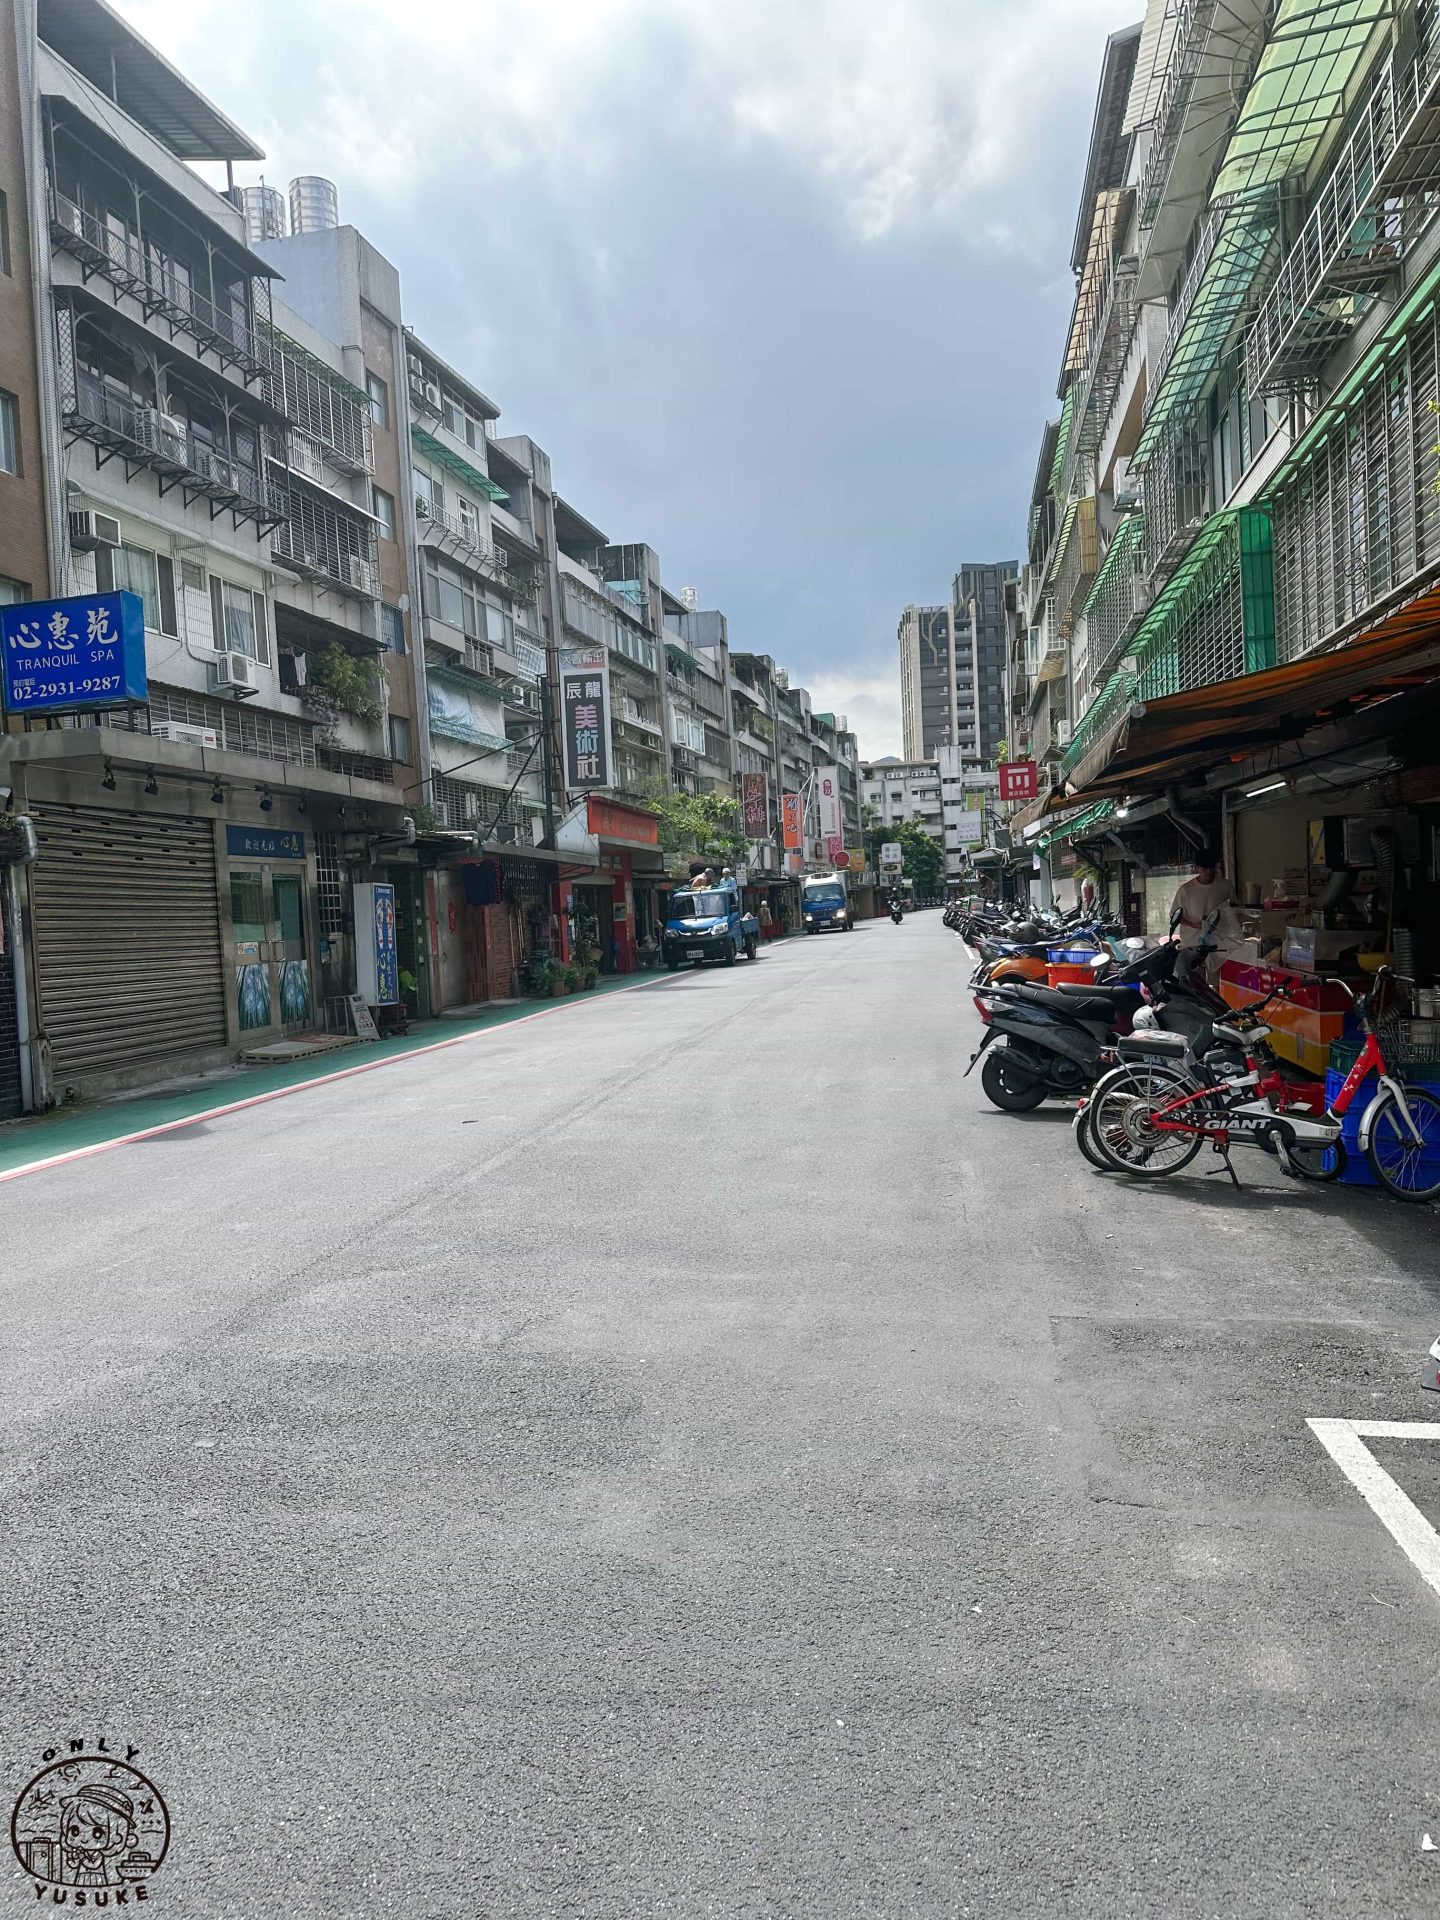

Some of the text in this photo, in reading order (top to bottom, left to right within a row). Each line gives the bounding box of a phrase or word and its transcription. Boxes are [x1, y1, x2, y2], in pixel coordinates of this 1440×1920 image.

[9, 608, 118, 650] 心惠苑
[17, 650, 114, 670] TRANQUIL SPA
[13, 676, 120, 700] 02-2931-9287
[566, 682, 601, 699] 辰龍
[575, 704, 600, 779] 美術社
[1204, 1119, 1271, 1129] GIANT
